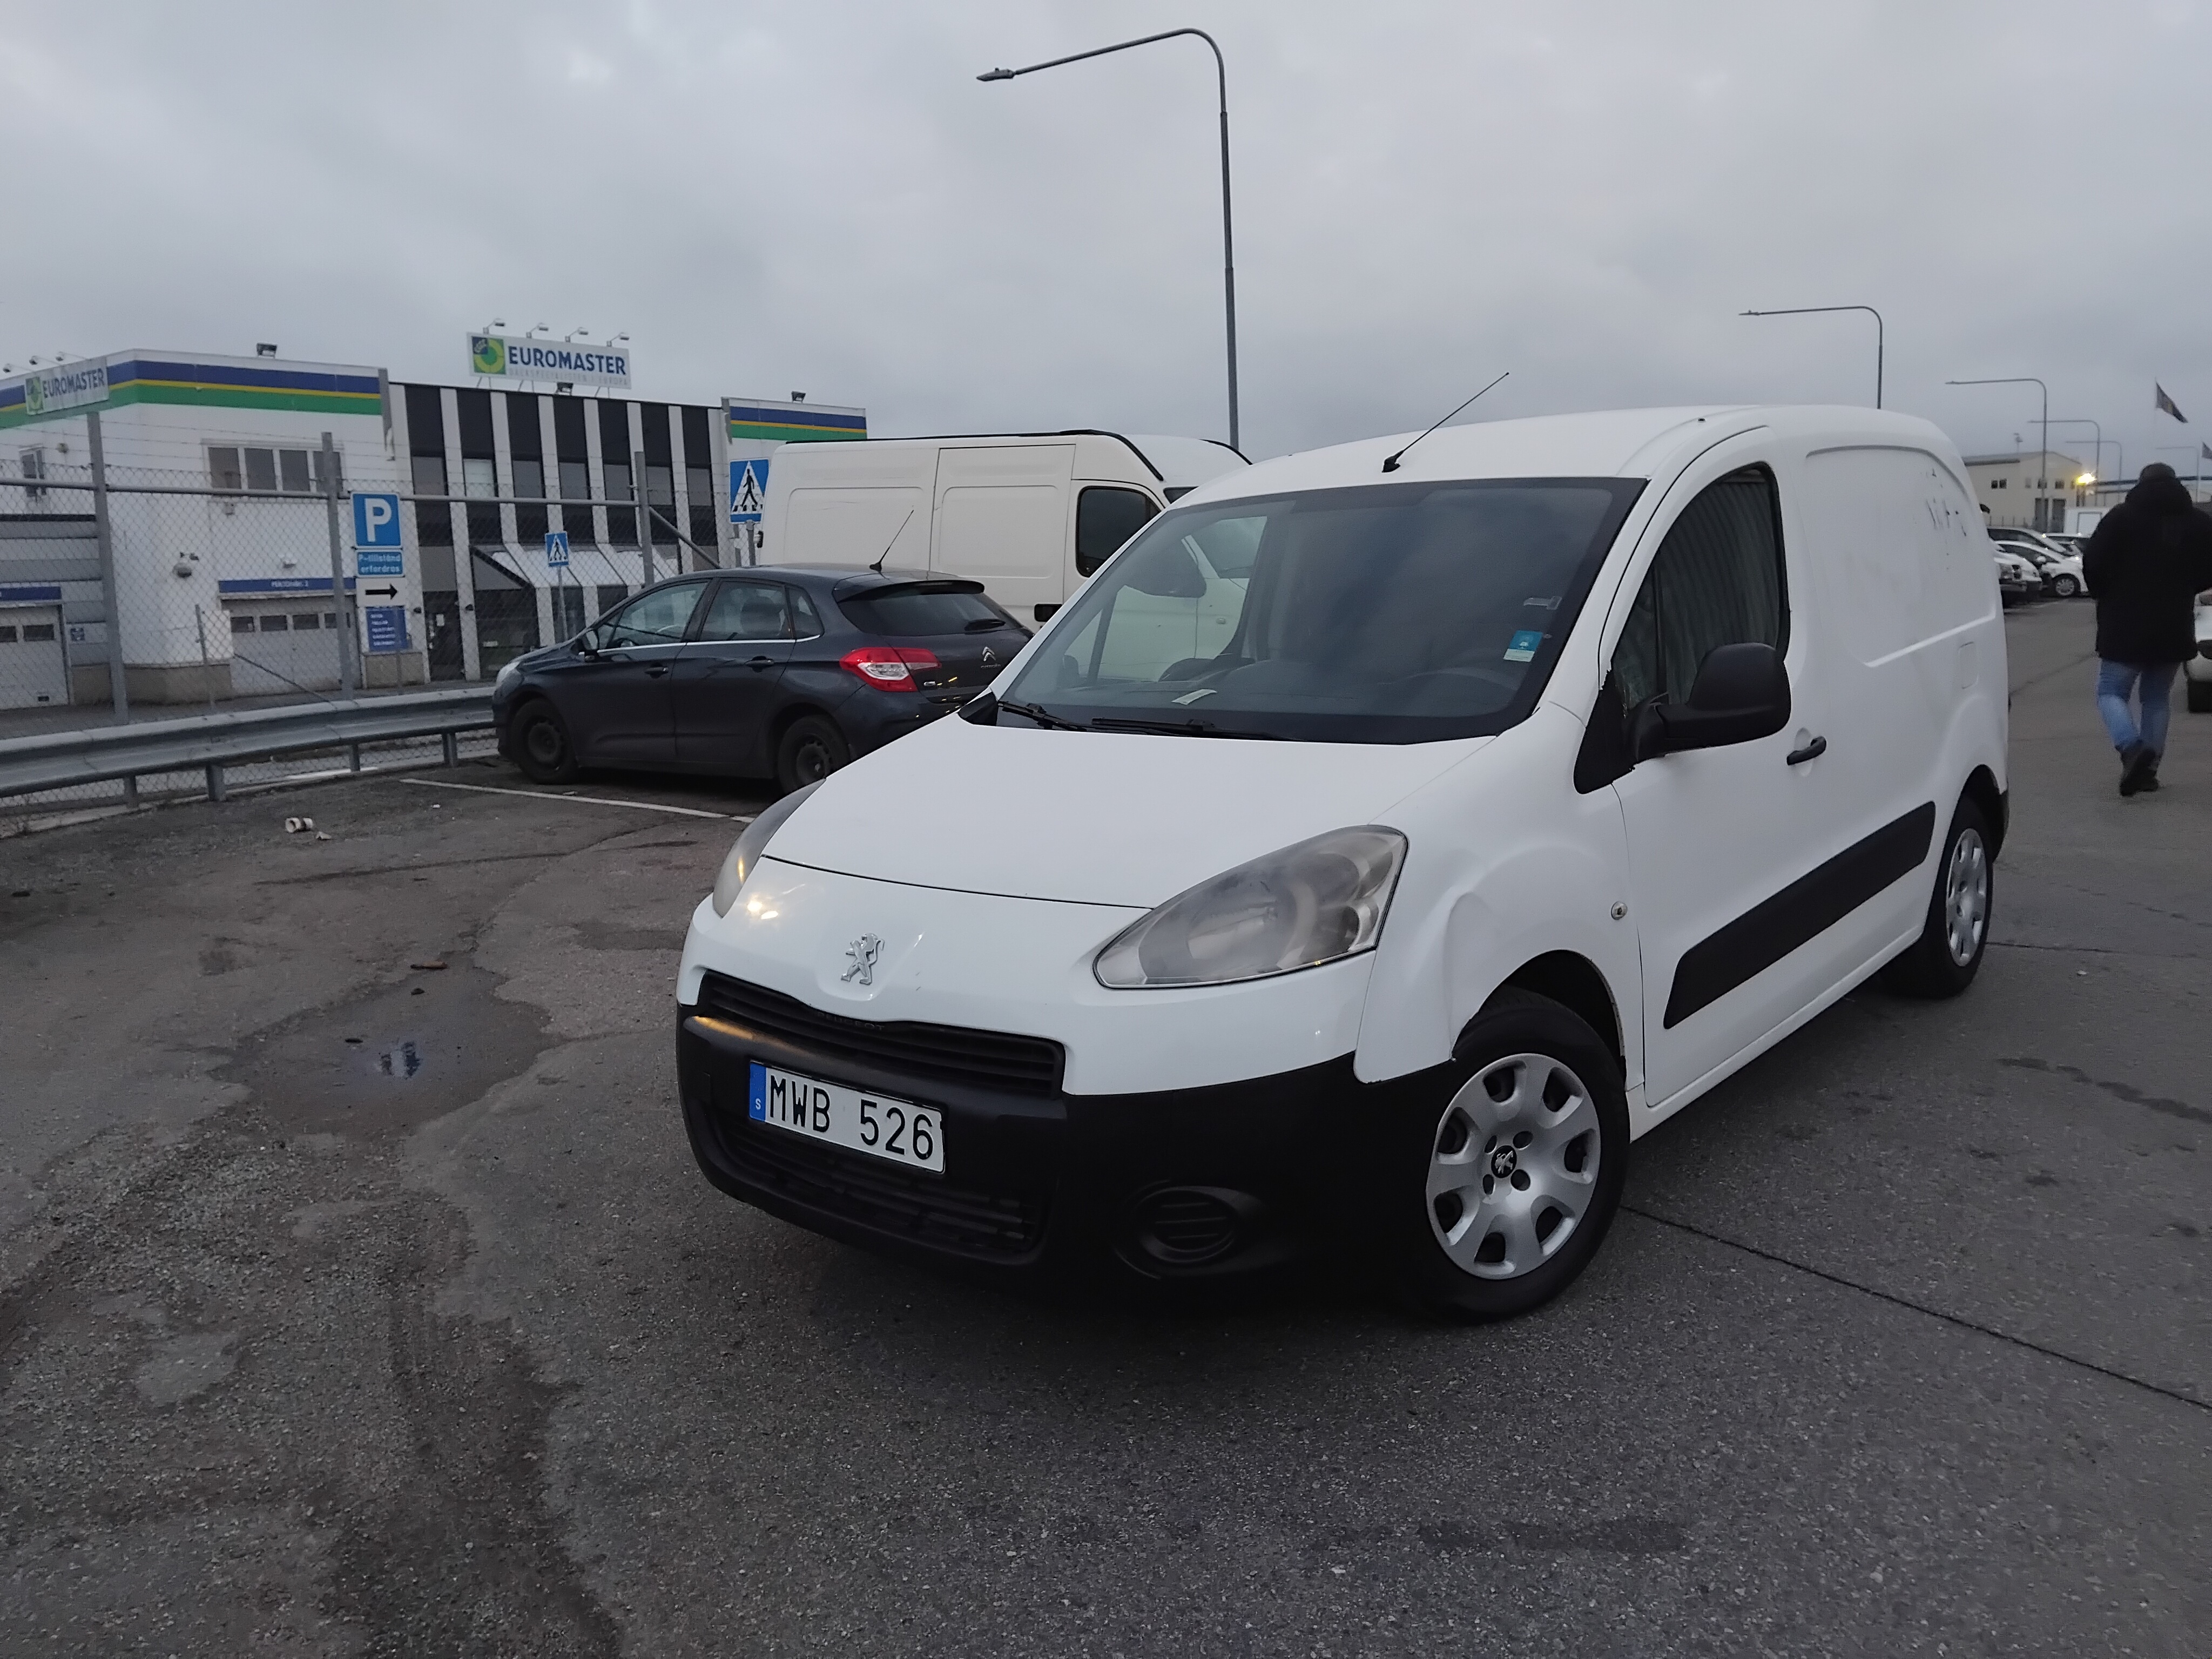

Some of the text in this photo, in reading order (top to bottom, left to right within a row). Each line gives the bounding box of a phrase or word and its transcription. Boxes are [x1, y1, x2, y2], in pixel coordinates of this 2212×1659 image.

[508, 345, 626, 376] EUROMASTER
[42, 368, 105, 398] EUROMASTER
[365, 498, 392, 543] P
[754, 1097, 762, 1110] S
[770, 1075, 934, 1160] MWB 526
